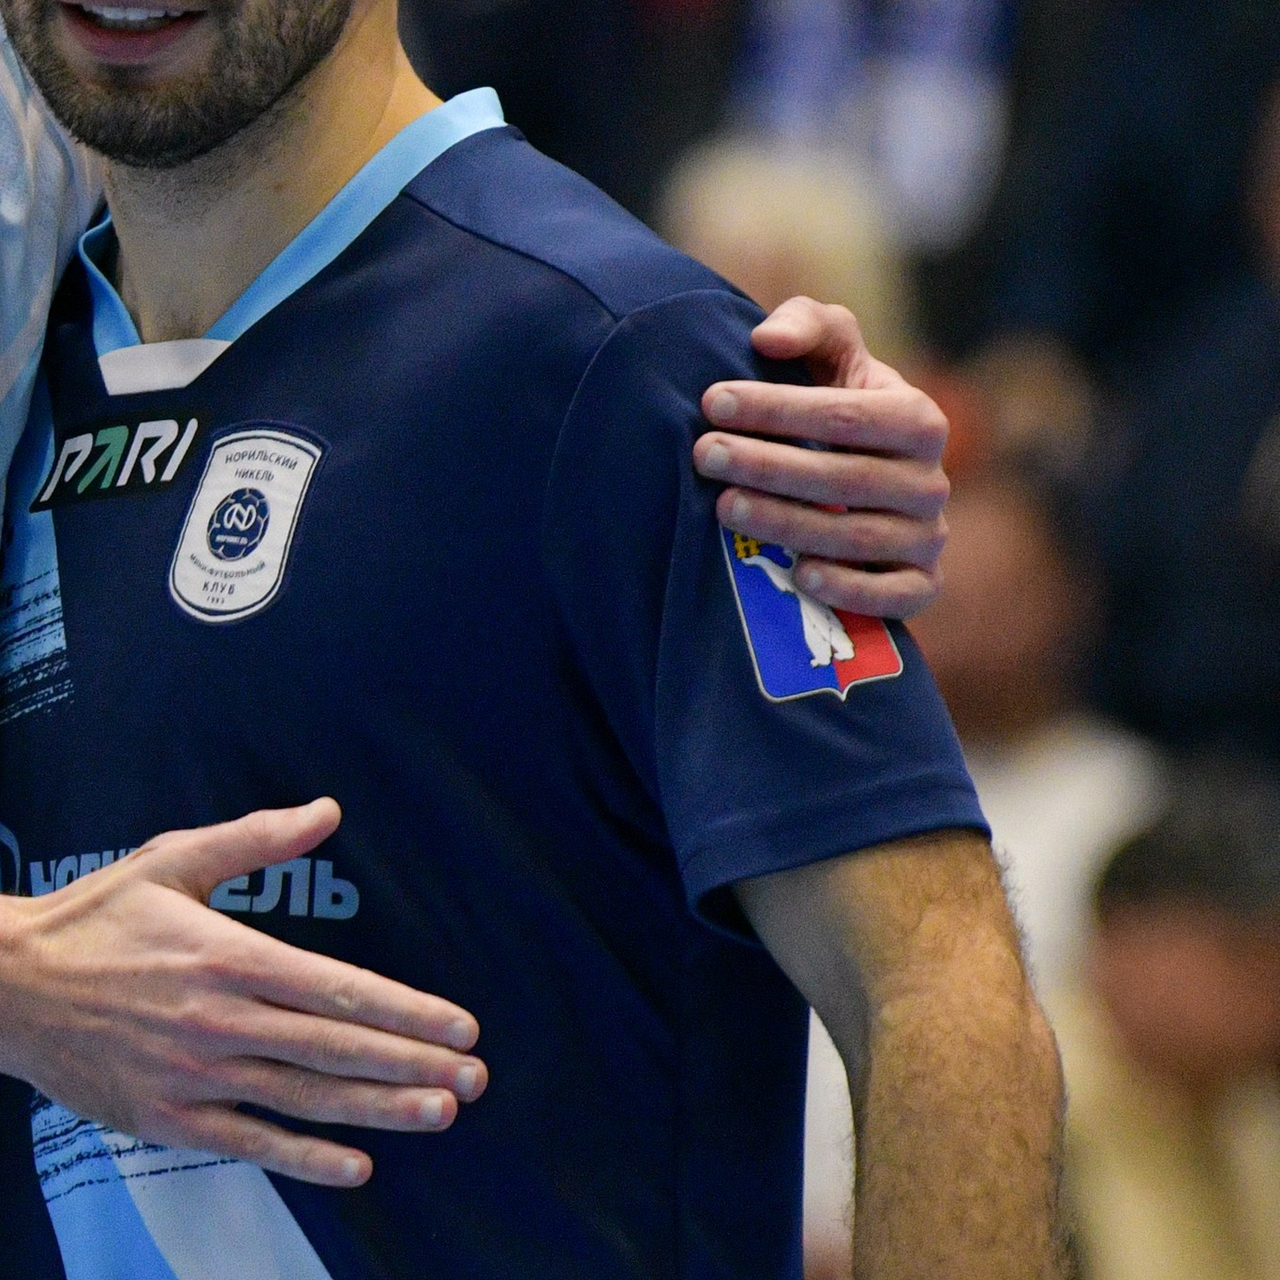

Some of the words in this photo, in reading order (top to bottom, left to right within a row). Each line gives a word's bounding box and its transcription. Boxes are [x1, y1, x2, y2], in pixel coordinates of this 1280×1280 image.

[39, 418, 199, 502] PARI
[225, 449, 298, 471] НОРИЛЬСКИЙ
[234, 468, 275, 482] НИКЕЛЬ
[202, 581, 235, 595] КЛУБ
